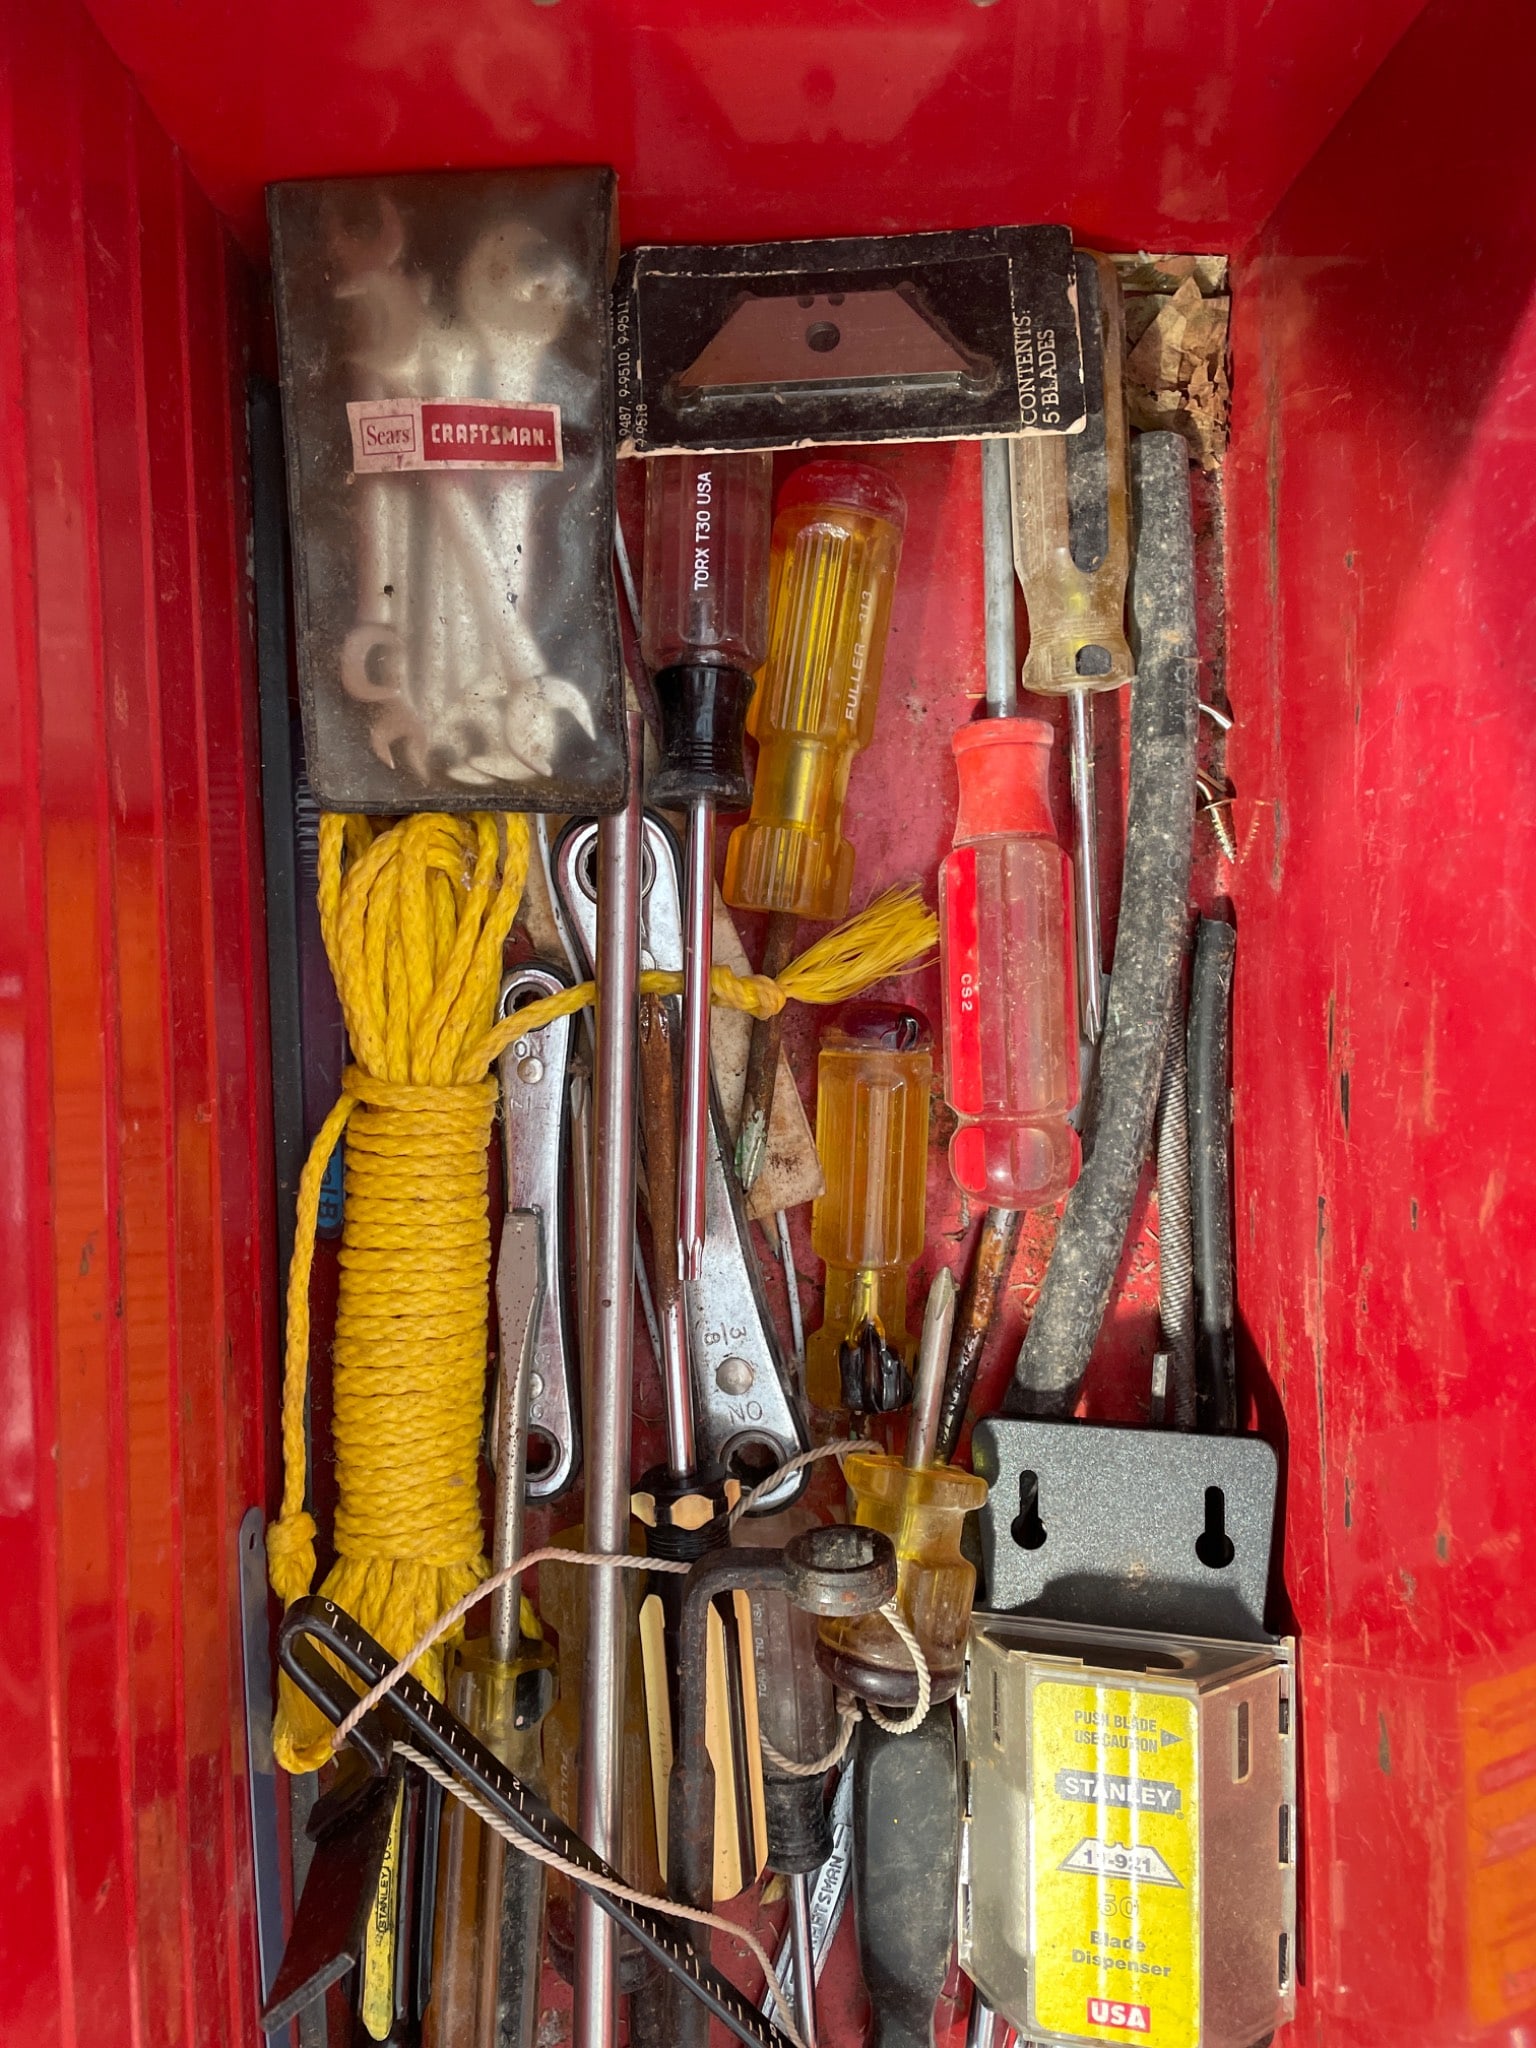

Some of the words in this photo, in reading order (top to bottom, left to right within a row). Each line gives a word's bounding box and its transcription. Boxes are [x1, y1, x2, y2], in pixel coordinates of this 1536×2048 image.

[1014, 309, 1038, 425] CONTENTS:
[1036, 328, 1060, 406] BLADES
[1042, 411, 1060, 424] 5
[366, 424, 411, 447] Sears
[696, 471, 712, 505] USA
[695, 510, 711, 543] T30
[693, 547, 710, 591] TORX
[845, 642, 867, 721] FULLER
[960, 973, 973, 1013] CS2
[1074, 1709, 1110, 1729] PUSH
[1113, 1714, 1158, 1733] BLADE
[1074, 1729, 1099, 1746] USE
[1064, 1776, 1173, 1808] STANLEY
[378, 1871, 389, 1932] STANLEY
[811, 1854, 846, 1950] AFTSMAN
[1090, 1930, 1147, 1953] Blade
[1071, 1949, 1171, 1978] Dispenser
[1091, 2001, 1147, 2029] USA
